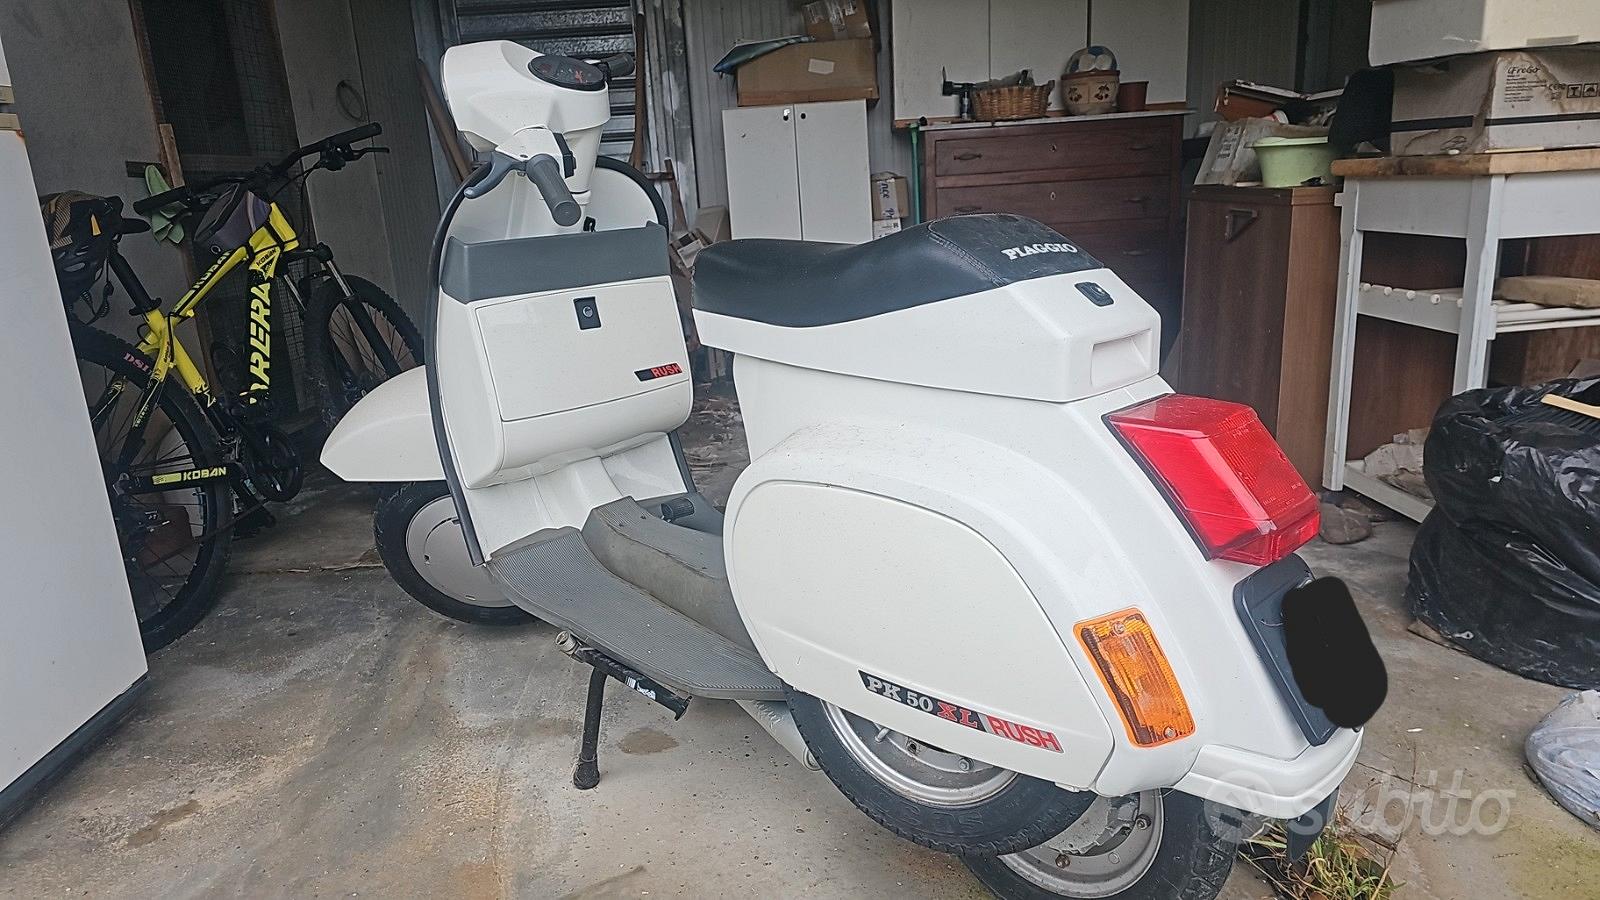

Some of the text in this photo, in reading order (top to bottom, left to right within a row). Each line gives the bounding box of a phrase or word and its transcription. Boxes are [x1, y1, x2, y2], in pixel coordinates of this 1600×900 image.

[1001, 243, 1078, 260] PIAGGIO
[650, 364, 682, 378] RUSH
[867, 675, 1062, 752] PK 50 XL RUSH
